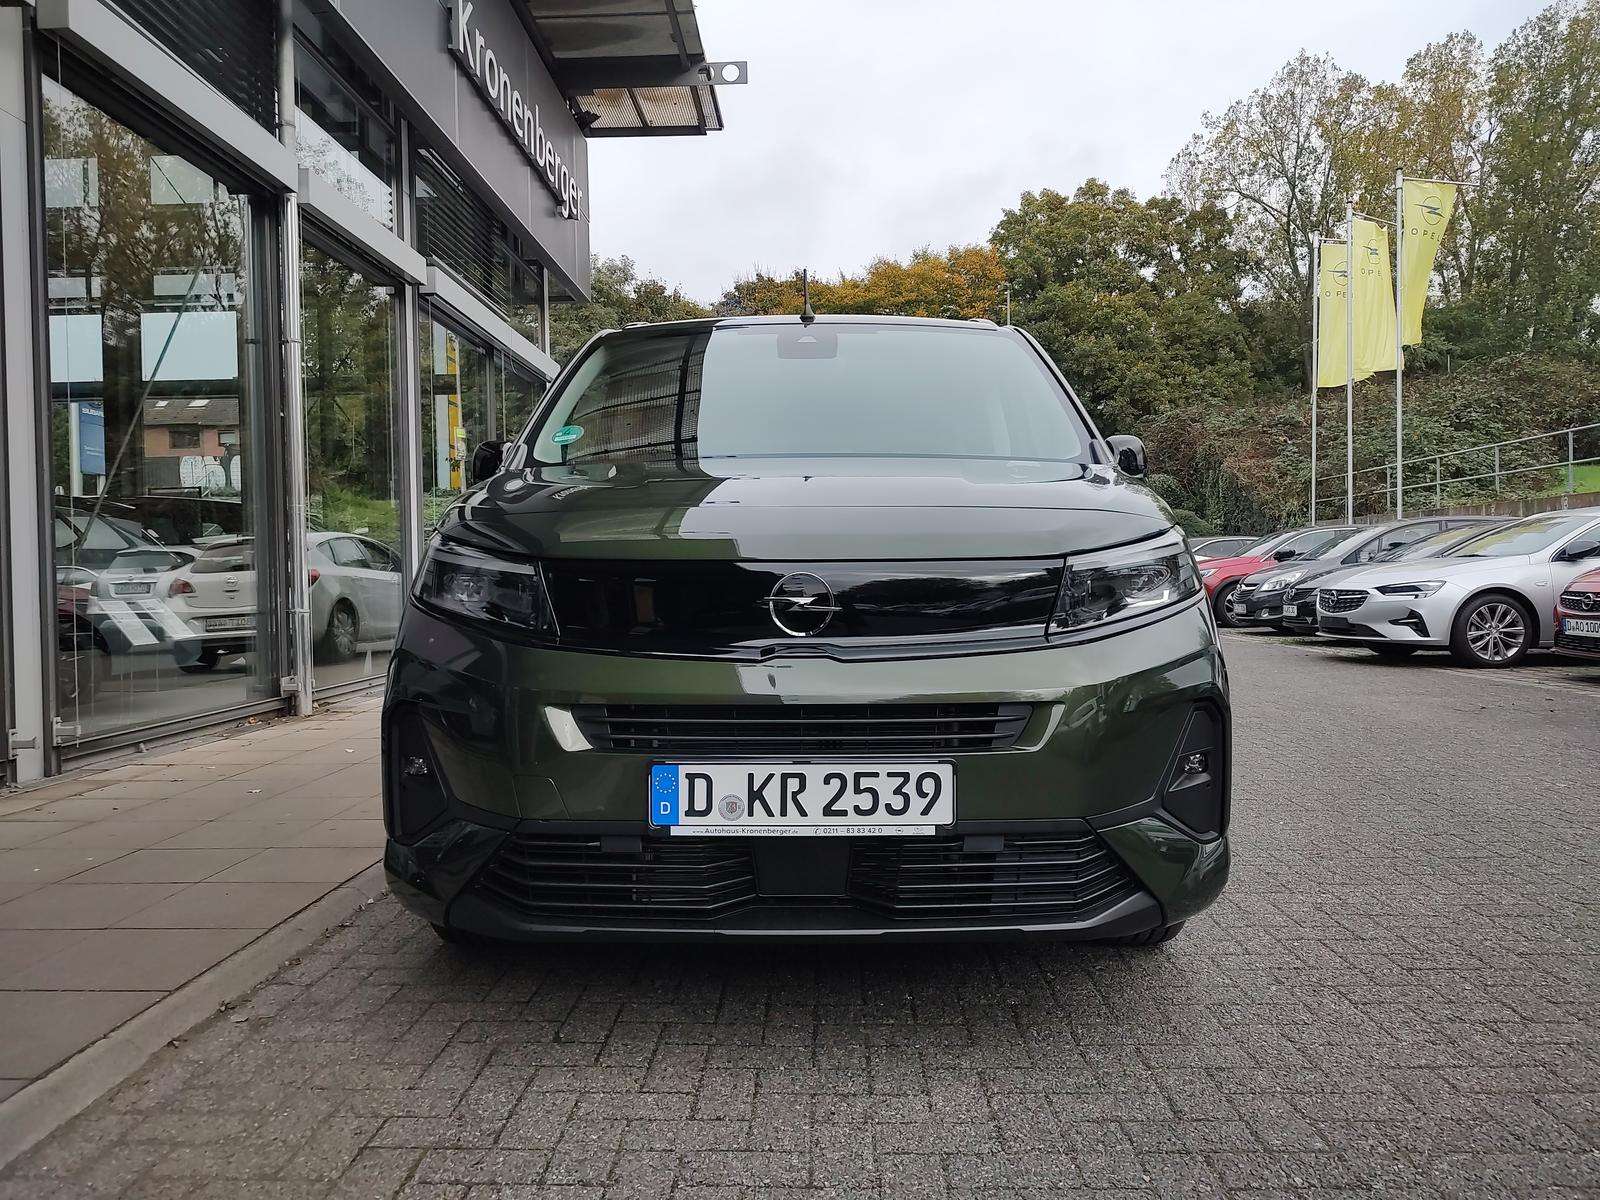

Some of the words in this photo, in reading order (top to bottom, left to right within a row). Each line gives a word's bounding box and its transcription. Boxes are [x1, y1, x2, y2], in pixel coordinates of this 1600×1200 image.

[459, 0, 583, 220] Kronenberger
[1586, 622, 1600, 633] 100
[660, 801, 671, 815] D
[685, 772, 713, 817] D
[747, 772, 808, 818] KR
[823, 771, 942, 817] 2539
